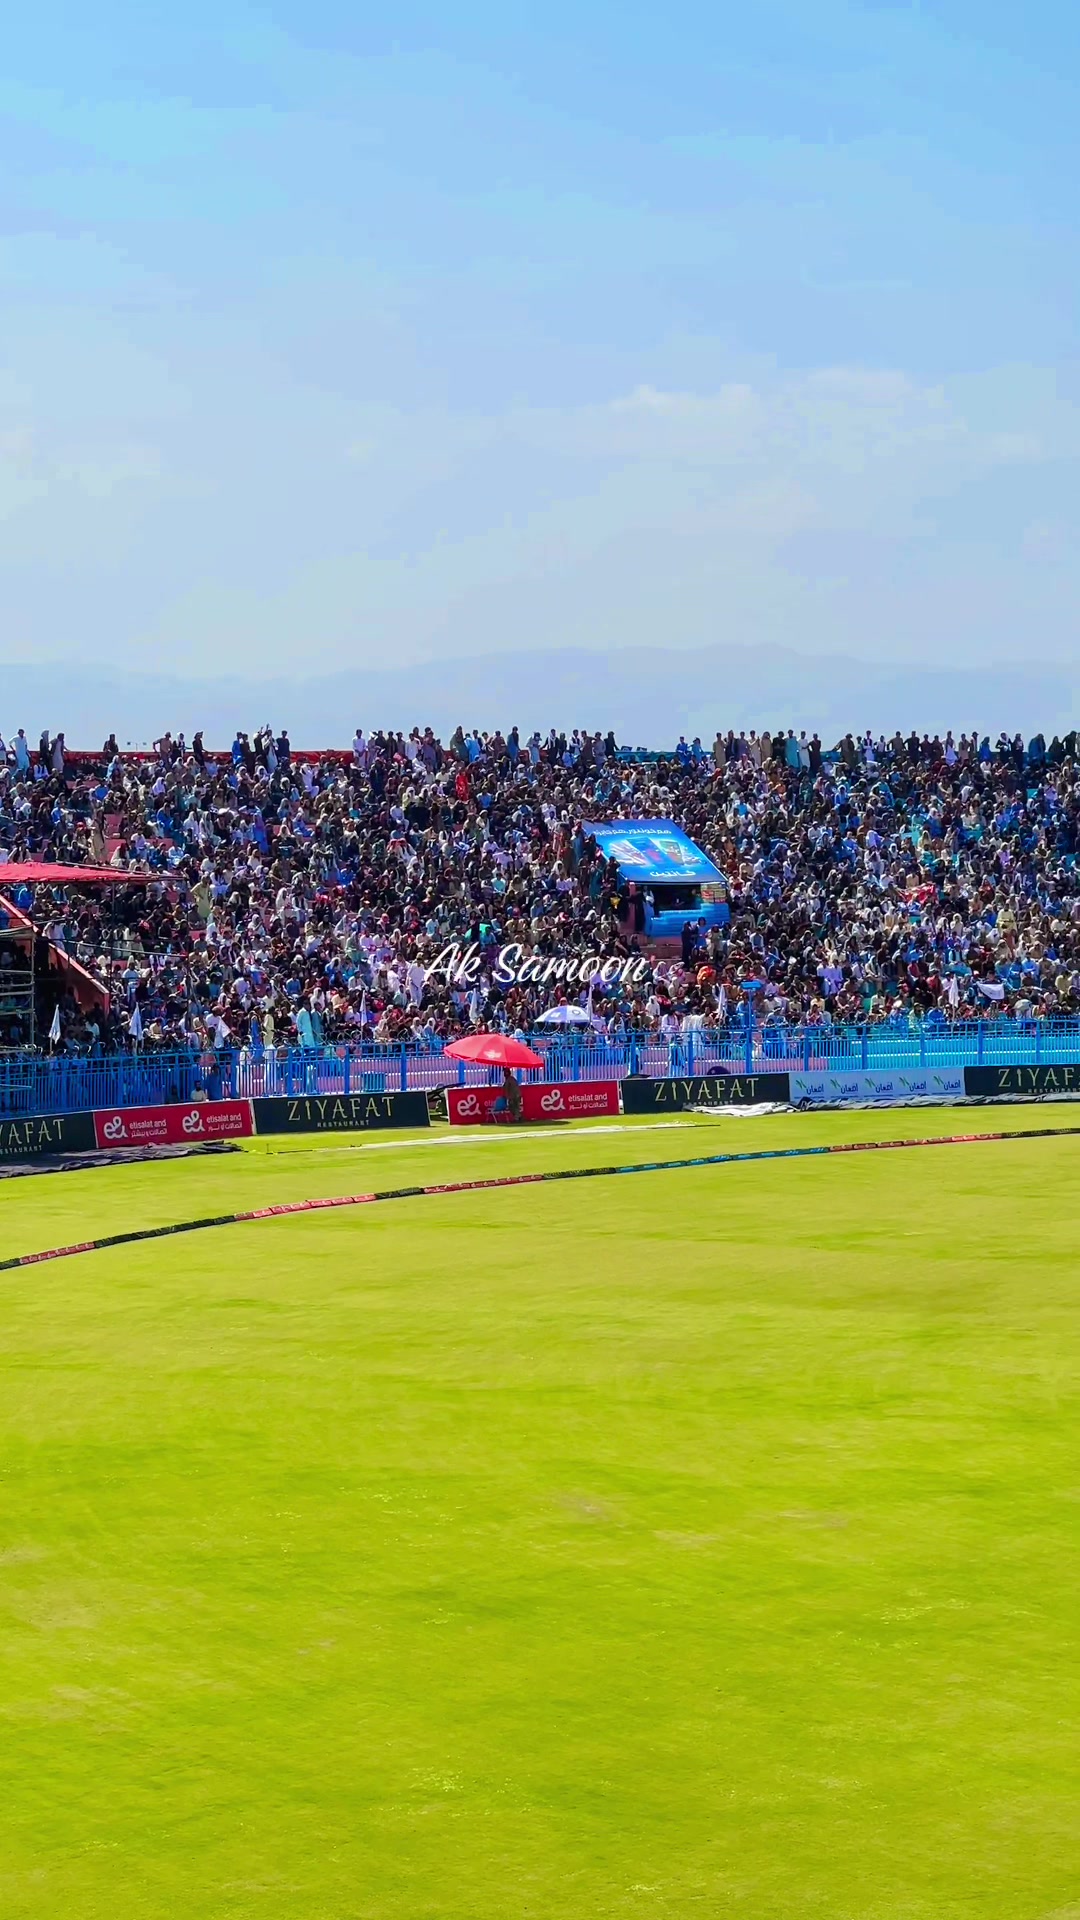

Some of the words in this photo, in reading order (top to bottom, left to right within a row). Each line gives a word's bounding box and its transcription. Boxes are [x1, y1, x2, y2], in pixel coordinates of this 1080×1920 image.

[998, 1067, 1080, 1088] ZIYAF
[568, 1094, 593, 1103] etisalat
[594, 1092, 608, 1101] and
[654, 1078, 759, 1102] ZIYAFAT
[287, 1096, 395, 1121] ZIYAFAT
[129, 1120, 153, 1129] etisalat
[154, 1119, 167, 1127] and
[206, 1114, 229, 1123] etisalat
[229, 1113, 242, 1121] and
